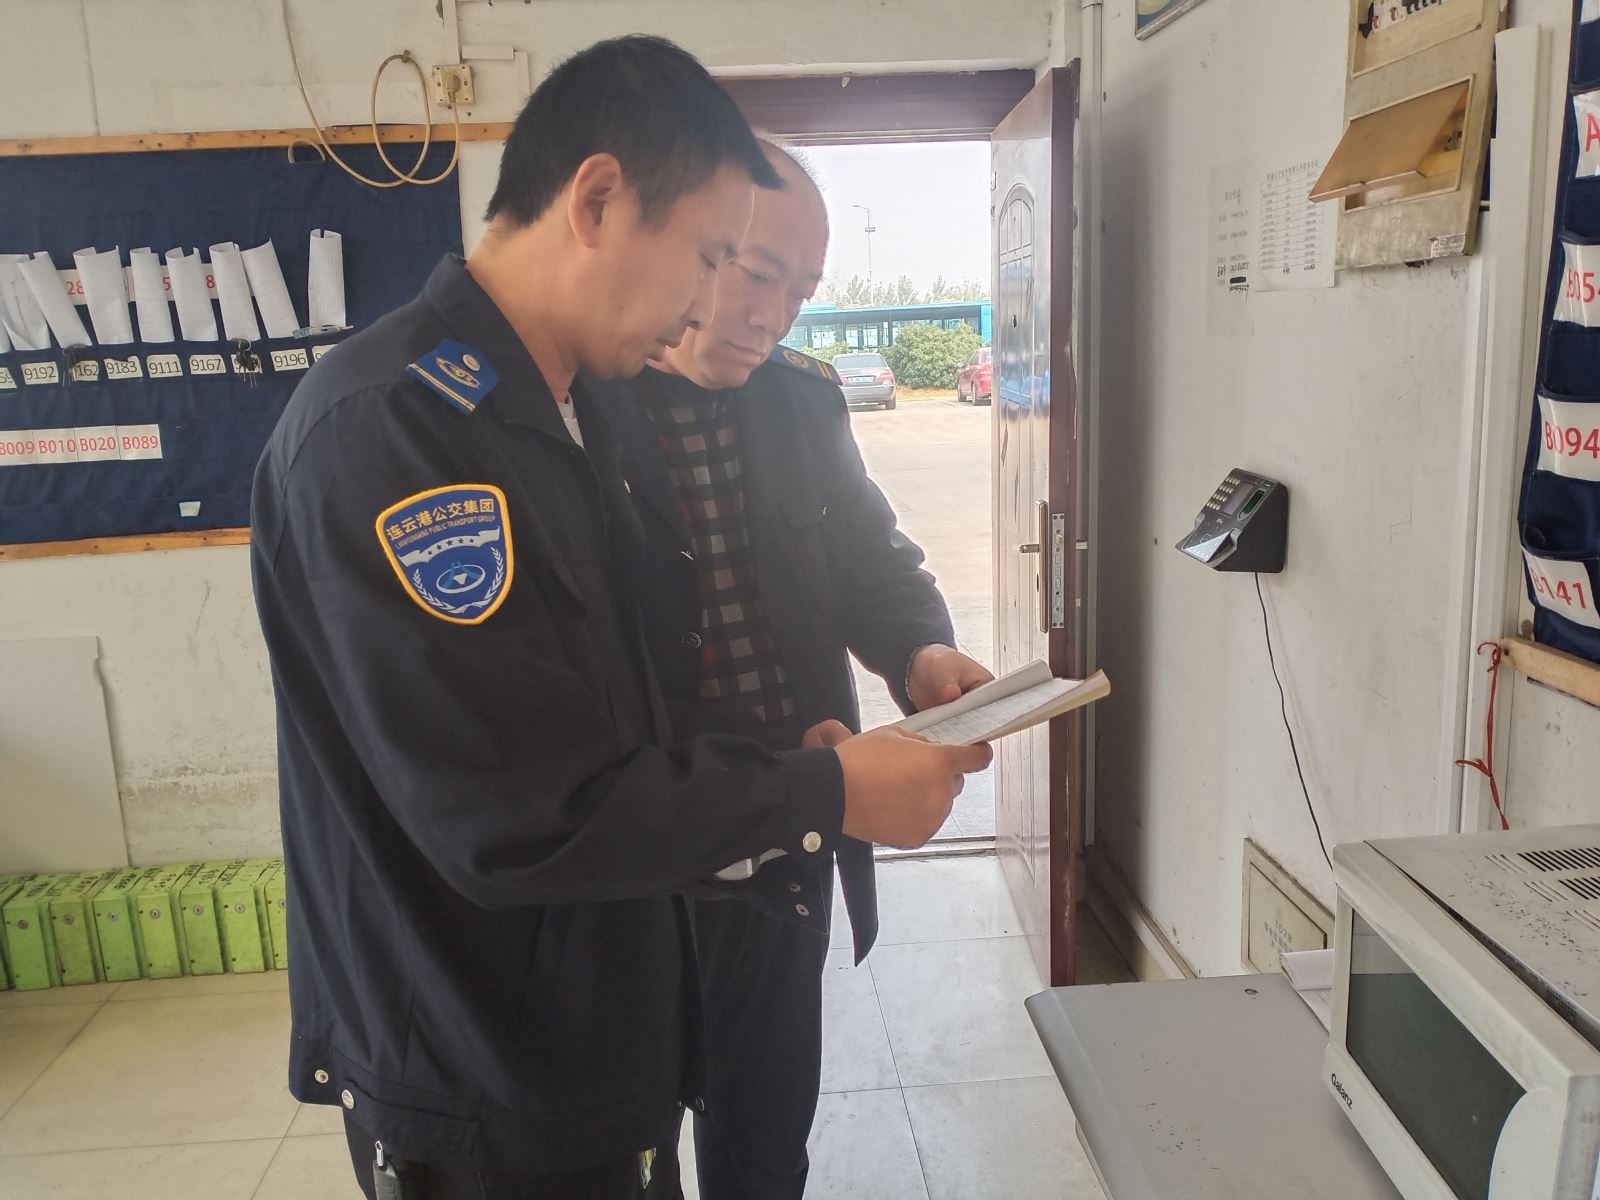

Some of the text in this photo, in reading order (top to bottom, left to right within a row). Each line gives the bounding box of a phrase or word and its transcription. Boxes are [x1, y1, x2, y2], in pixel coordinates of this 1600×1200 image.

[1566, 267, 1600, 303] B05
[106, 361, 137, 375] 9183
[149, 361, 181, 375] 9111
[191, 359, 221, 371] 9167
[274, 354, 307, 368] 9196
[24, 367, 56, 380] 9192
[38, 439, 76, 454] B010
[79, 436, 117, 452] B020
[122, 435, 159, 450] B089
[1544, 420, 1600, 459] B094
[0, 440, 35, 456] B009
[386, 498, 494, 541] 连云港公交集团
[1530, 567, 1587, 609] B141
[1331, 1073, 1352, 1109] Galanz
